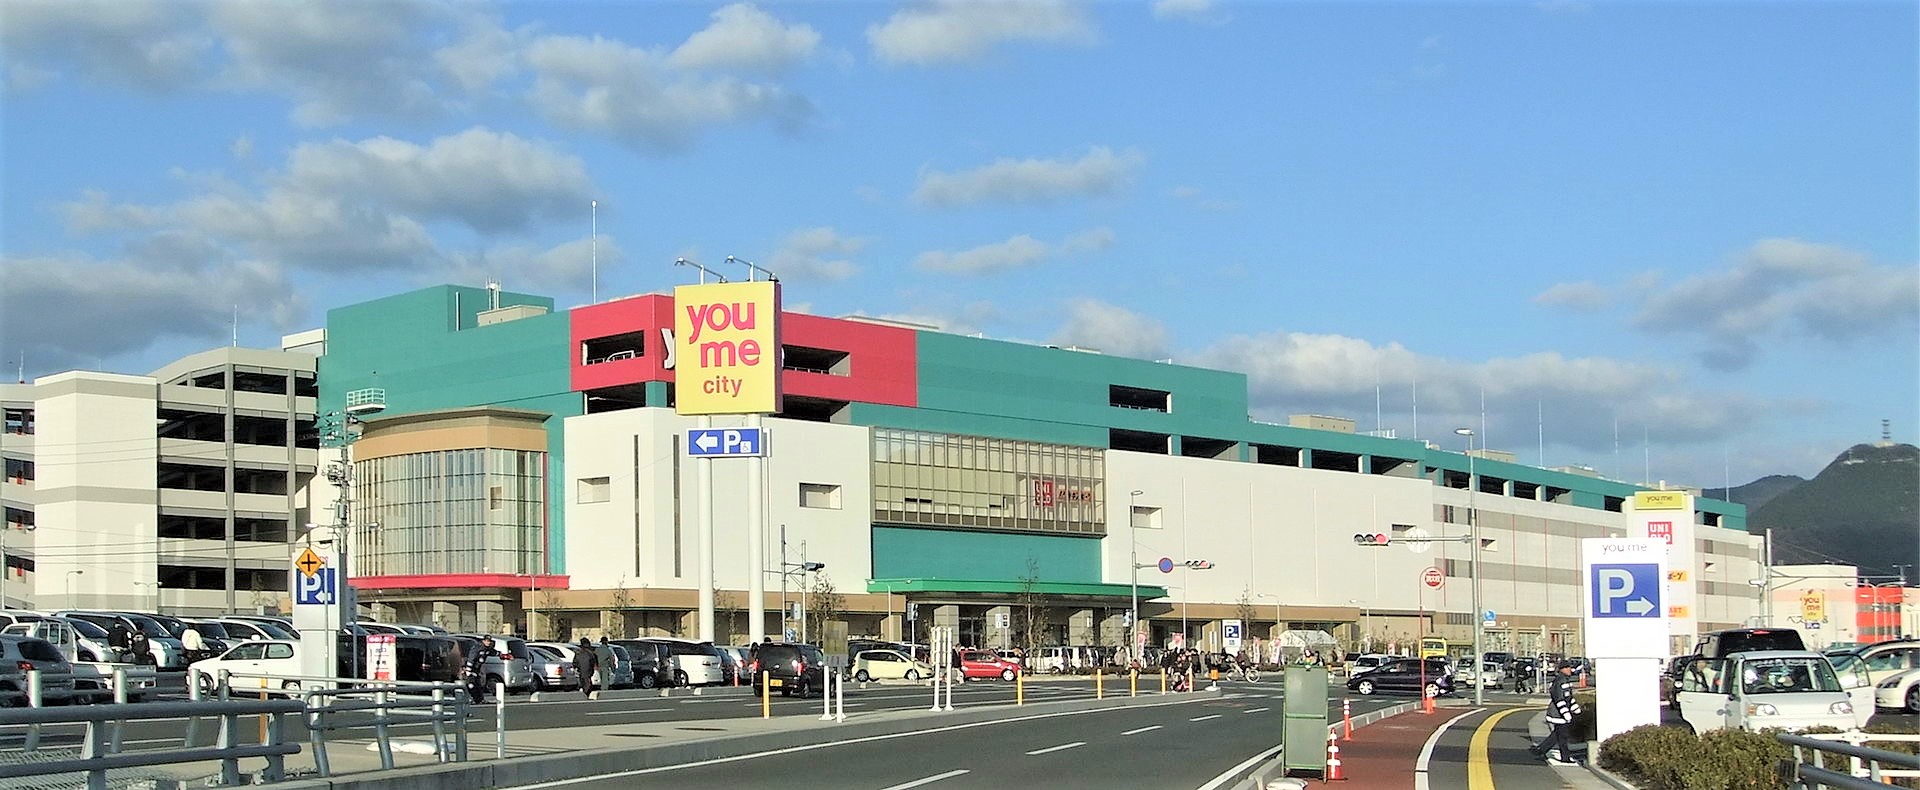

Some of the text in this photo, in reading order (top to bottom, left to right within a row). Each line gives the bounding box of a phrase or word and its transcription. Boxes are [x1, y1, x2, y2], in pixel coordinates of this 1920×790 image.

[686, 302, 756, 344] you
[700, 339, 761, 369] me
[703, 375, 743, 398] city
[723, 430, 741, 454] P
[1646, 495, 1659, 503] you
[1650, 523, 1669, 533] UNI
[1602, 543, 1647, 556] you me
[300, 573, 322, 602] P
[1599, 568, 1634, 614] P
[1803, 597, 1819, 605] you
[1226, 626, 1235, 637] P
